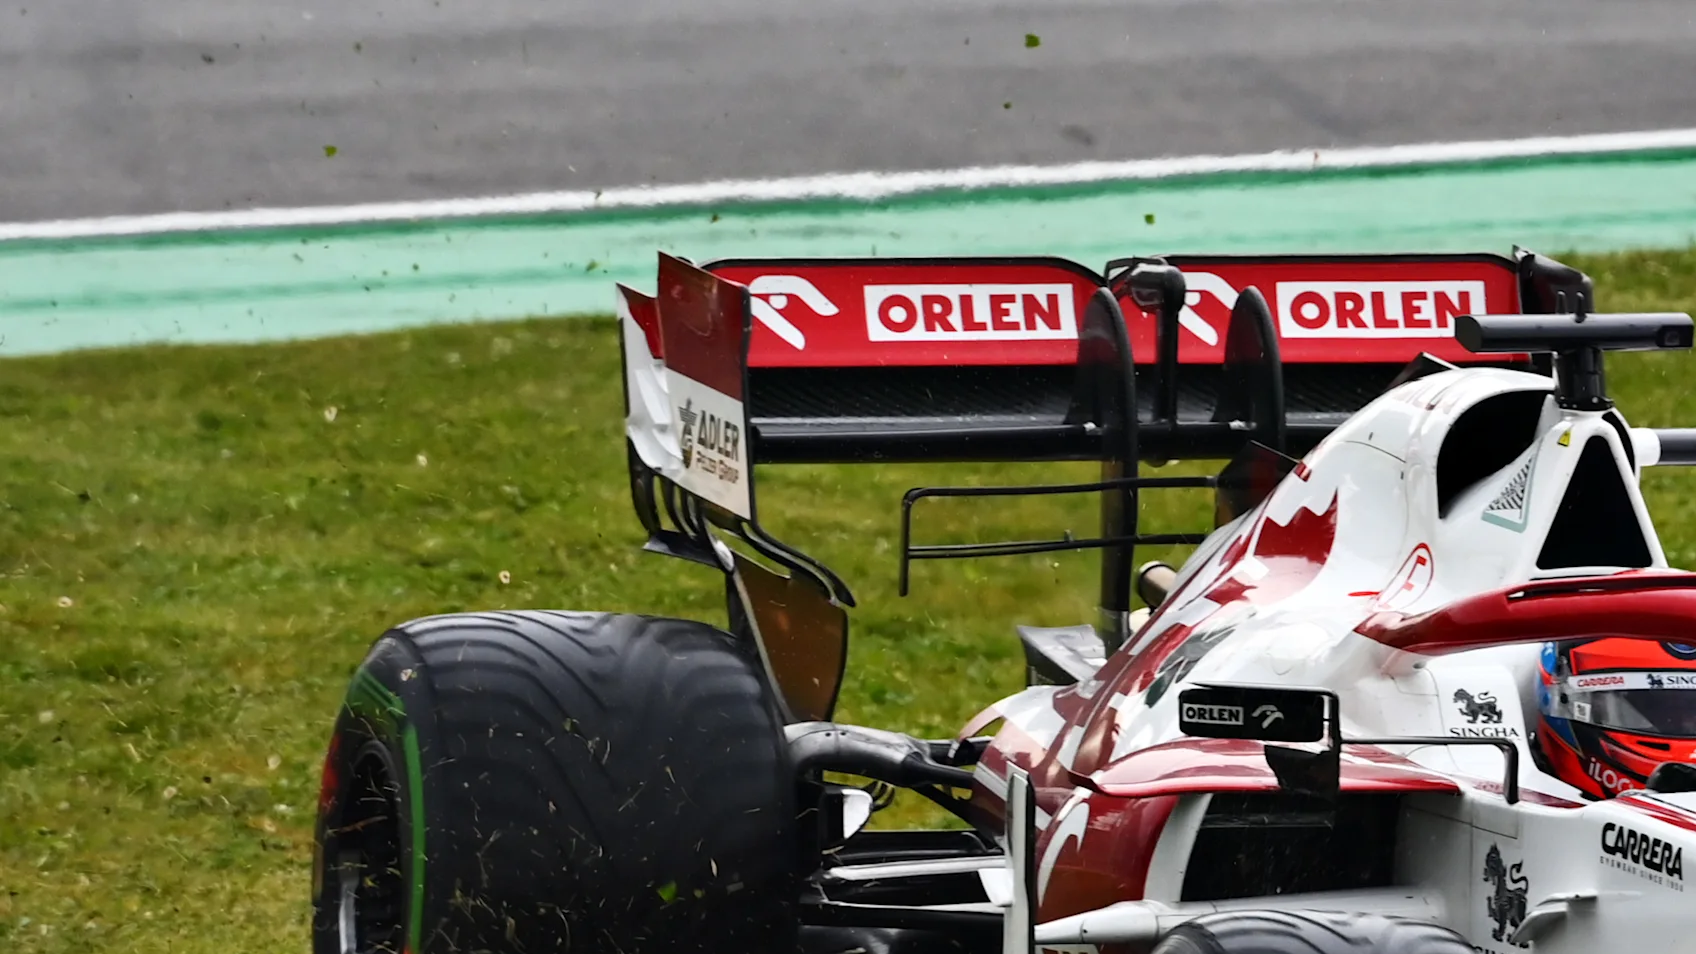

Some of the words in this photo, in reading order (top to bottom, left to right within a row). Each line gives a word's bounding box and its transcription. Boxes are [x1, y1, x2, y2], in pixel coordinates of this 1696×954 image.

[877, 293, 1062, 333] ORLEN
[1289, 290, 1472, 330] ORLEN
[697, 409, 739, 462] ADLER
[1577, 676, 1625, 687] CARRERA
[1185, 706, 1240, 722] ORLEN
[1449, 727, 1520, 737] SINGHA
[1601, 821, 1684, 881] CARRERA
